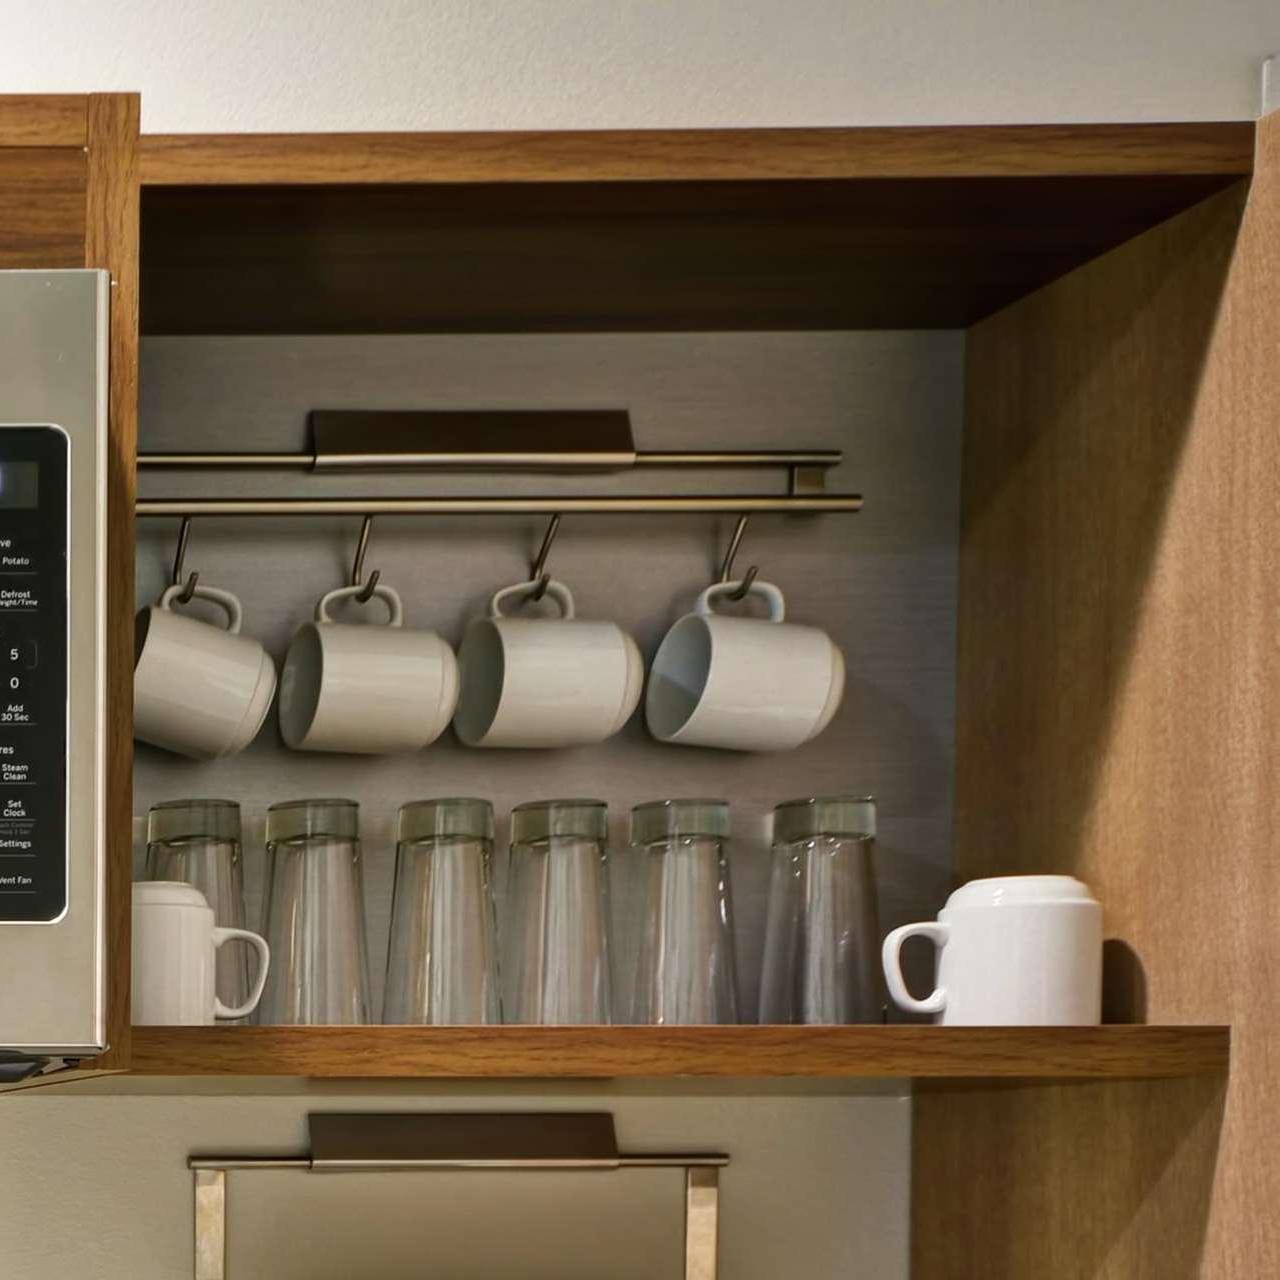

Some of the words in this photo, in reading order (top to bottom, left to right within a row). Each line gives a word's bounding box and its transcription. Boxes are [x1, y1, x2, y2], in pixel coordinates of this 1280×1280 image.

[2, 557, 29, 566] Potato
[1, 590, 31, 599] Defrost
[10, 649, 19, 660] 5
[10, 677, 19, 689] 0
[7, 704, 24, 712] Add
[1, 713, 12, 721] 30
[14, 713, 29, 721] Sec
[1, 763, 28, 772] Steam
[3, 773, 27, 781] Clean
[7, 800, 22, 808] Set
[3, 809, 26, 817] Clock
[17, 876, 32, 885] Fan
